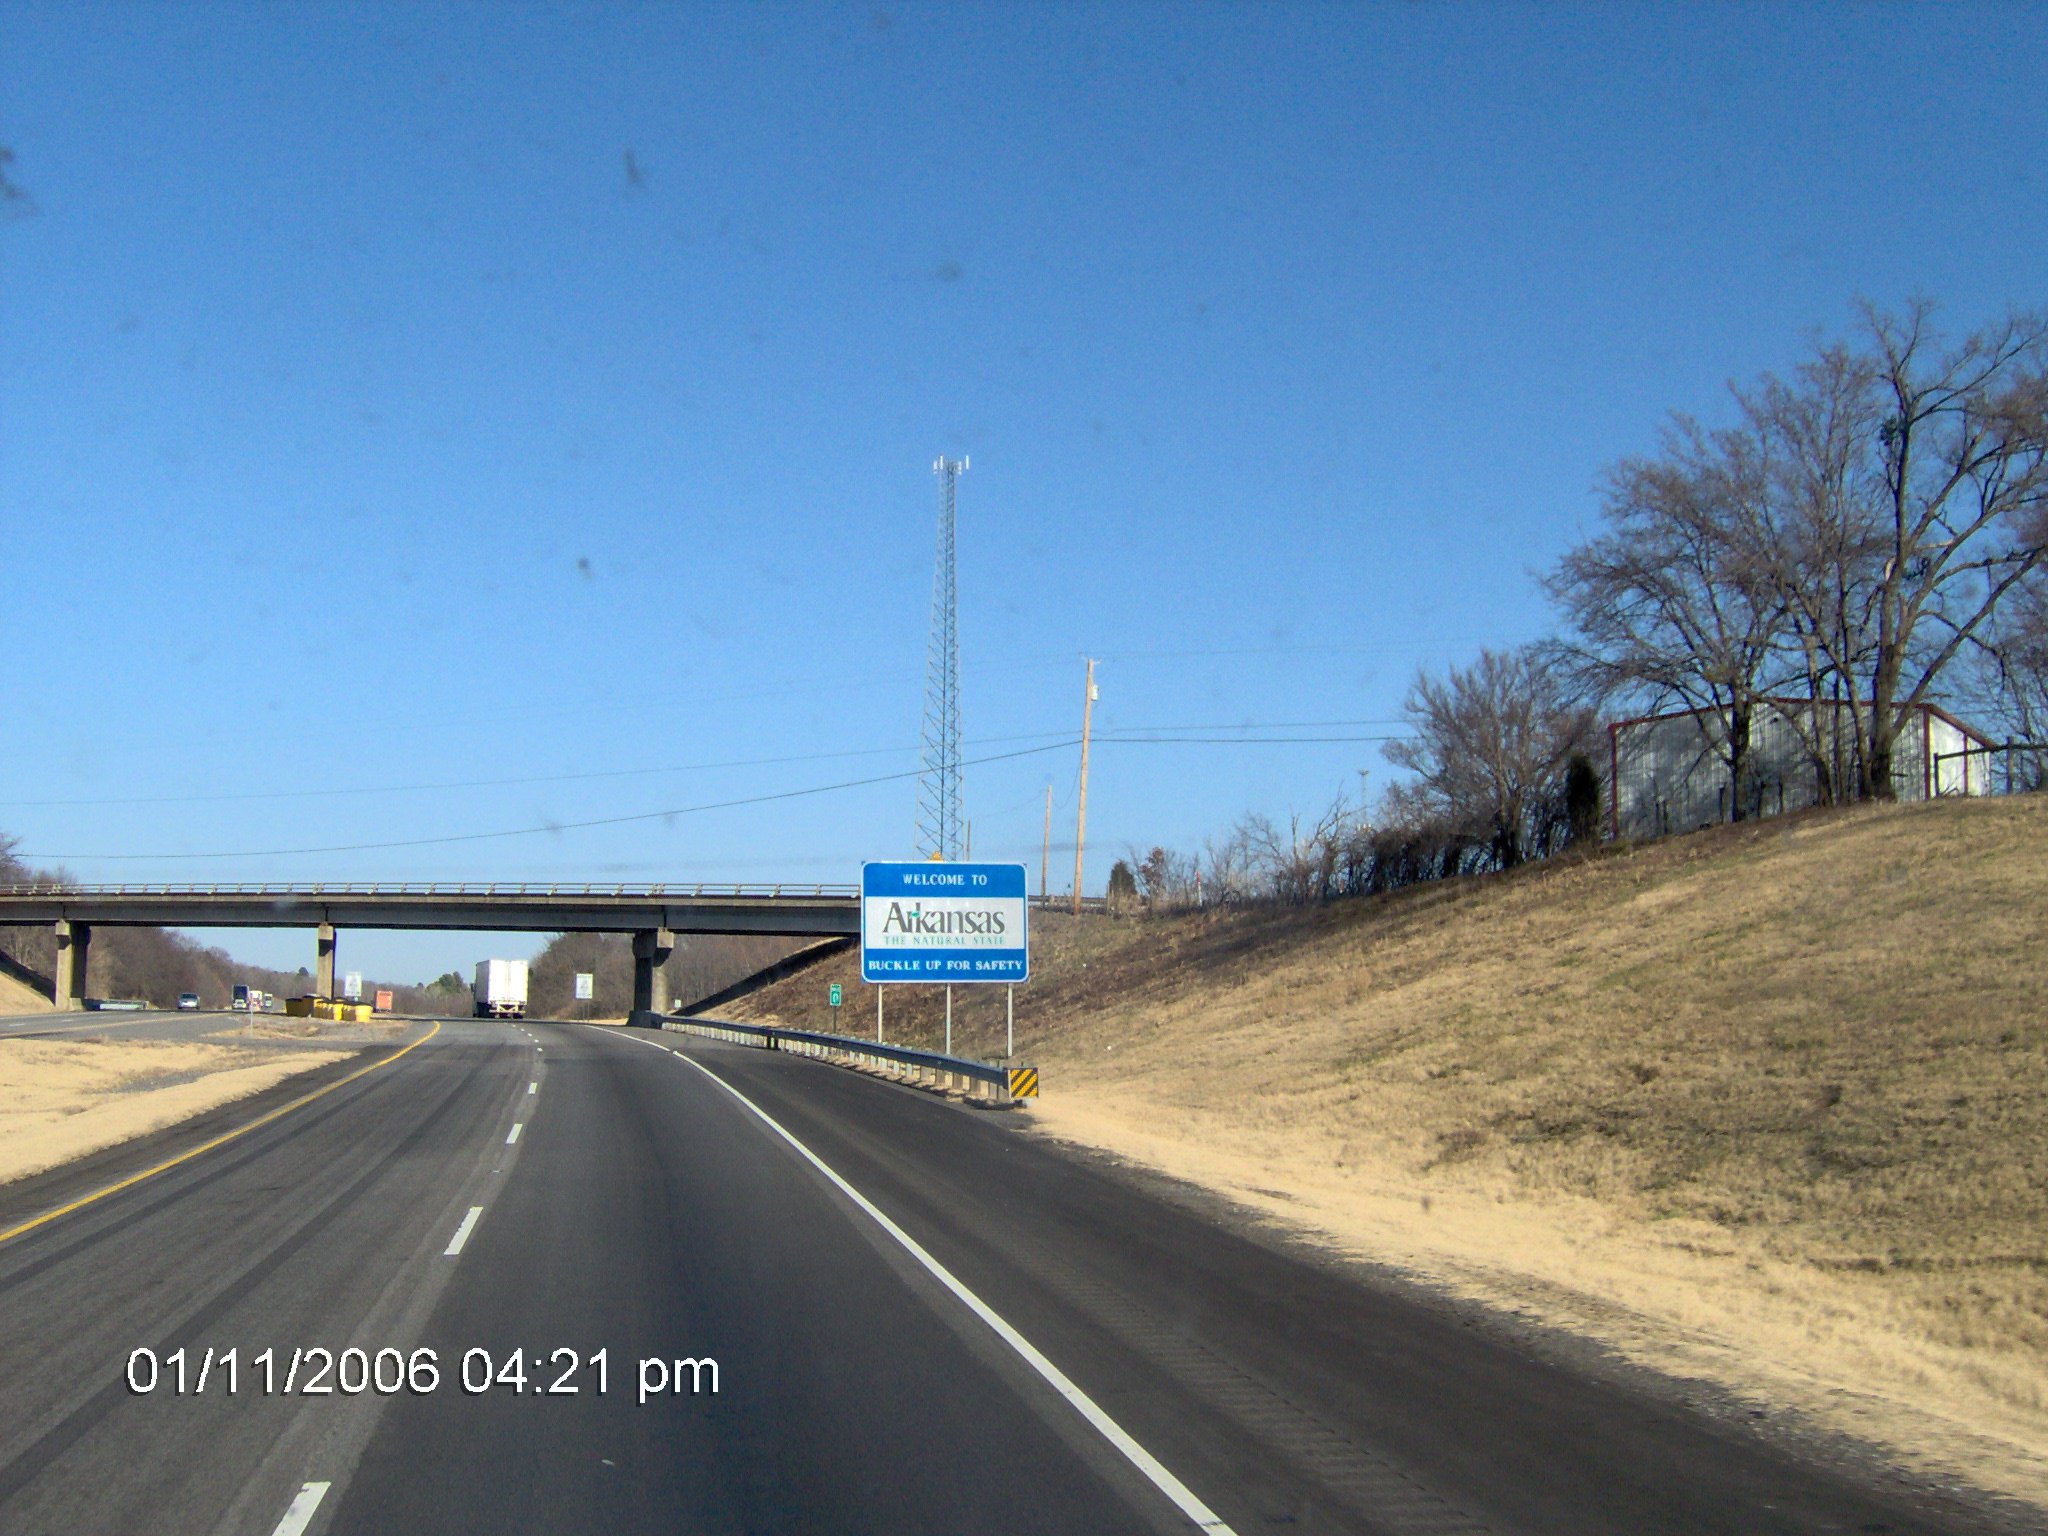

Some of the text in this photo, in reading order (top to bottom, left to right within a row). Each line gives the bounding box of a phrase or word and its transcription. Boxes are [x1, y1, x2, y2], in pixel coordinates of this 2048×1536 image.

[903, 874, 988, 886] WELCOME TO
[882, 901, 1006, 934] Arkansas
[884, 936, 1005, 945] THE NATURAL STATE
[868, 960, 1023, 971] BUCKLE UP FOR SAFETY
